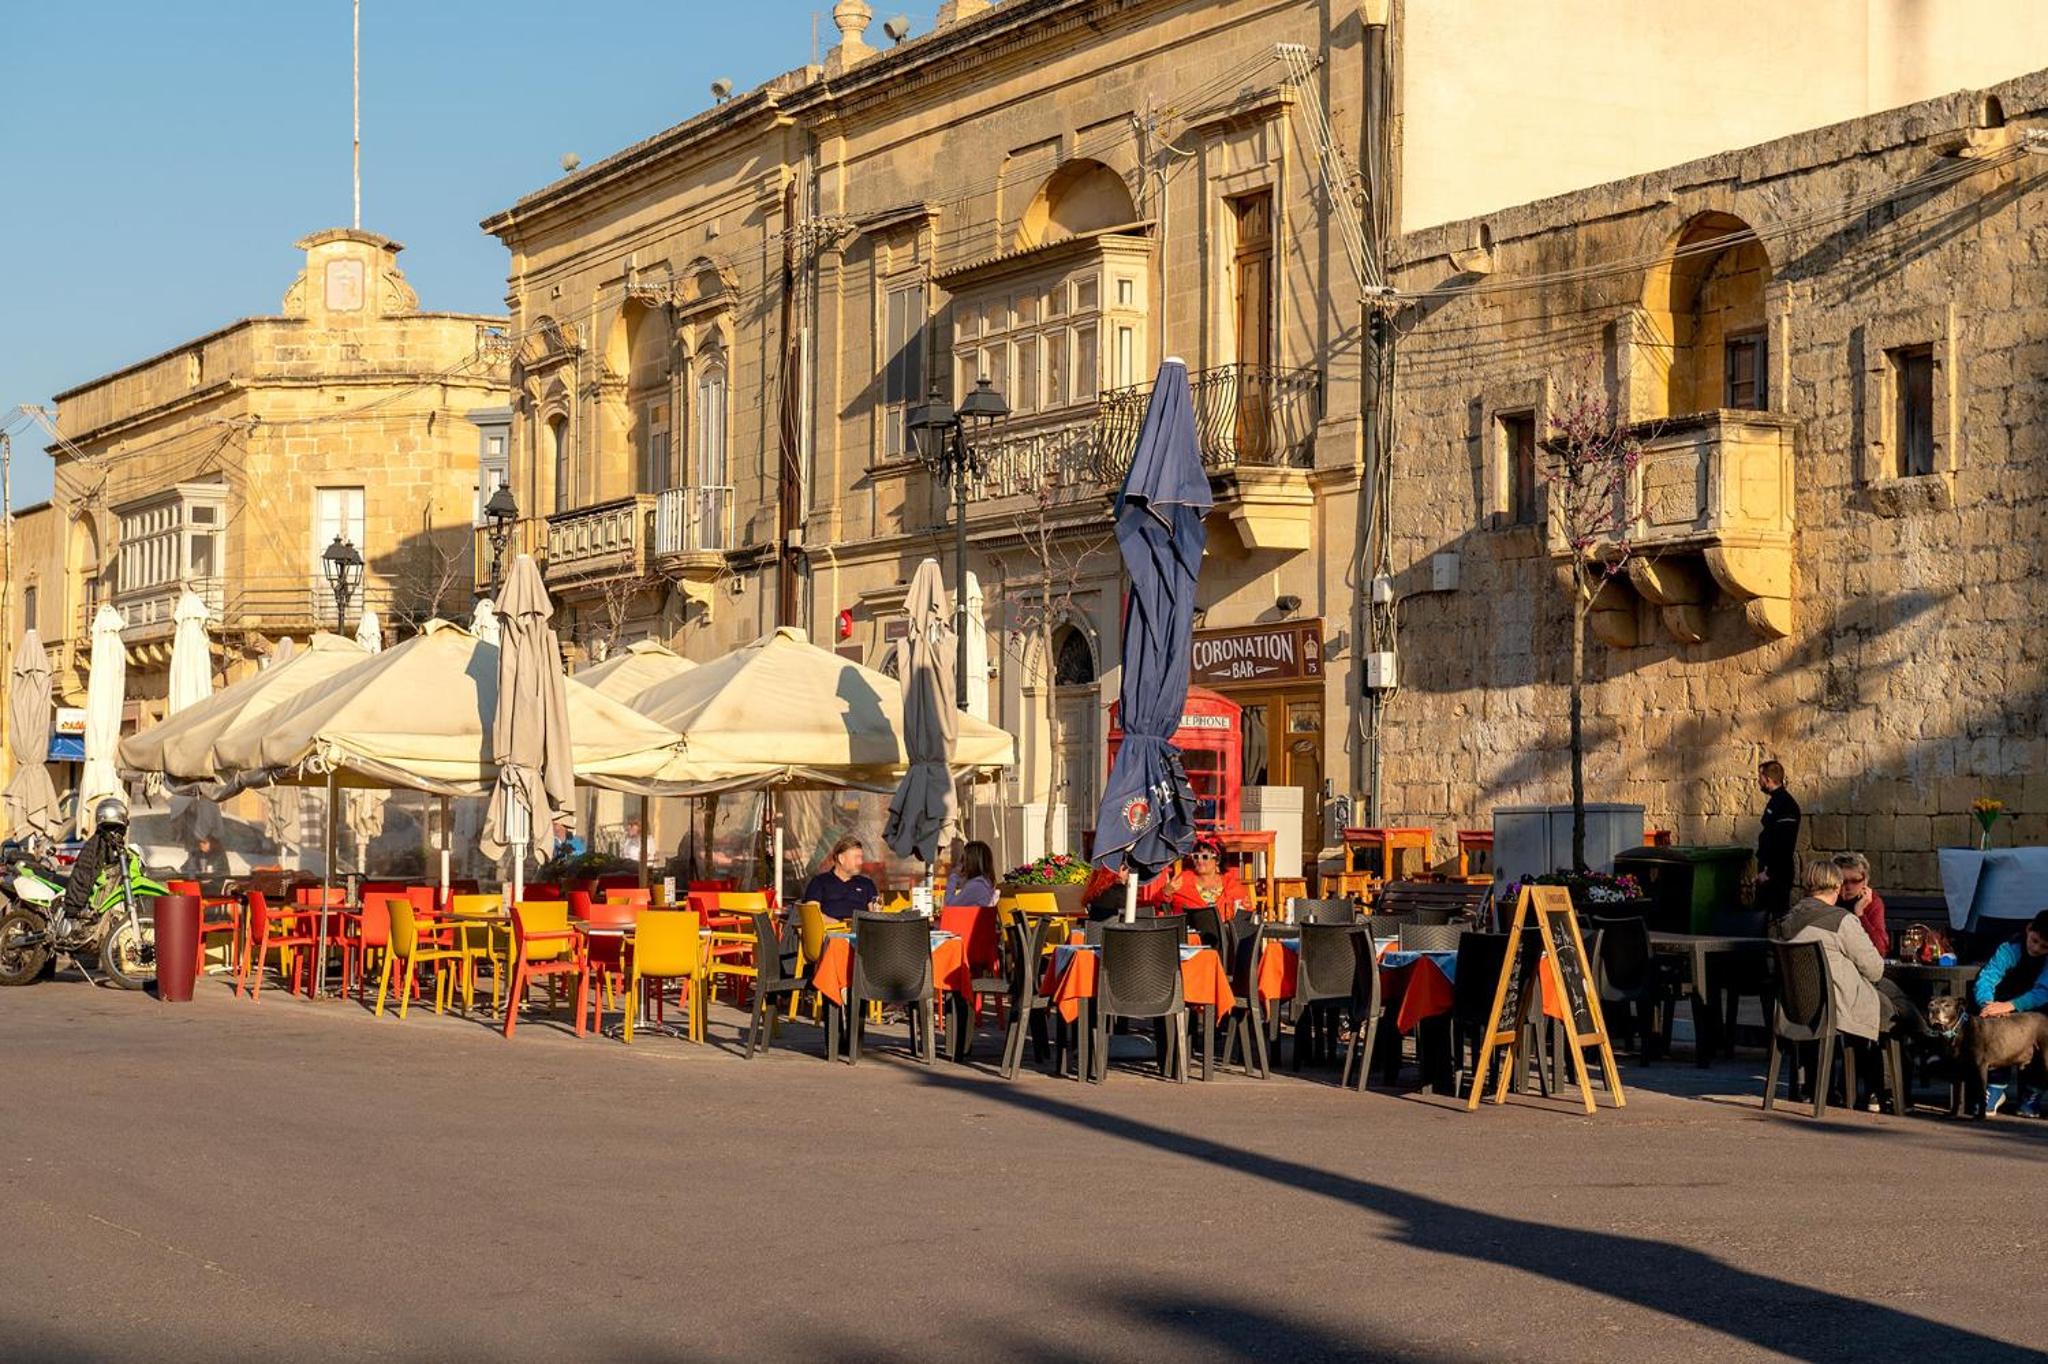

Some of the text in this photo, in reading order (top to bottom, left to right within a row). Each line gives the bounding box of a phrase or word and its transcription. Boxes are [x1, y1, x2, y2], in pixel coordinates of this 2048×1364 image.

[1192, 632, 1294, 671] CORONATION
[1232, 661, 1255, 679] BAR
[1308, 662, 1317, 673] 75
[1183, 715, 1228, 728] EPHONE
